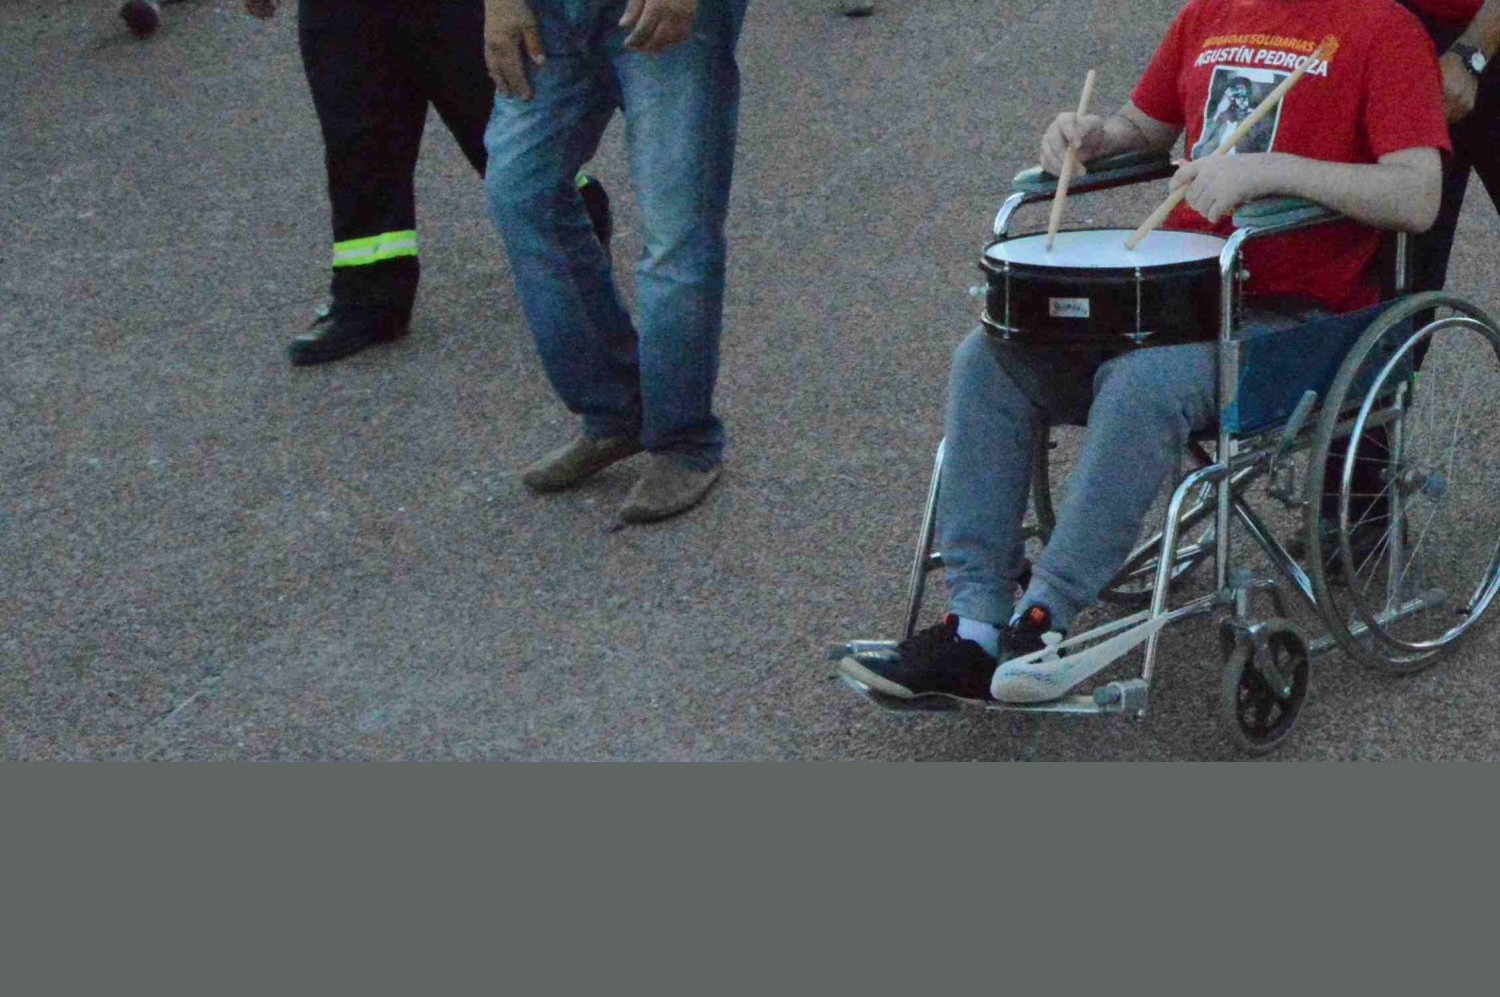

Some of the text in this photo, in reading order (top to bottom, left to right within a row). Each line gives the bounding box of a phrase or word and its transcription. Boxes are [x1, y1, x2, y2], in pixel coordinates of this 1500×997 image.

[1250, 34, 1315, 52] SOLIDARIAS
[1194, 45, 1329, 77] AGUSTÍN PEDROZA
